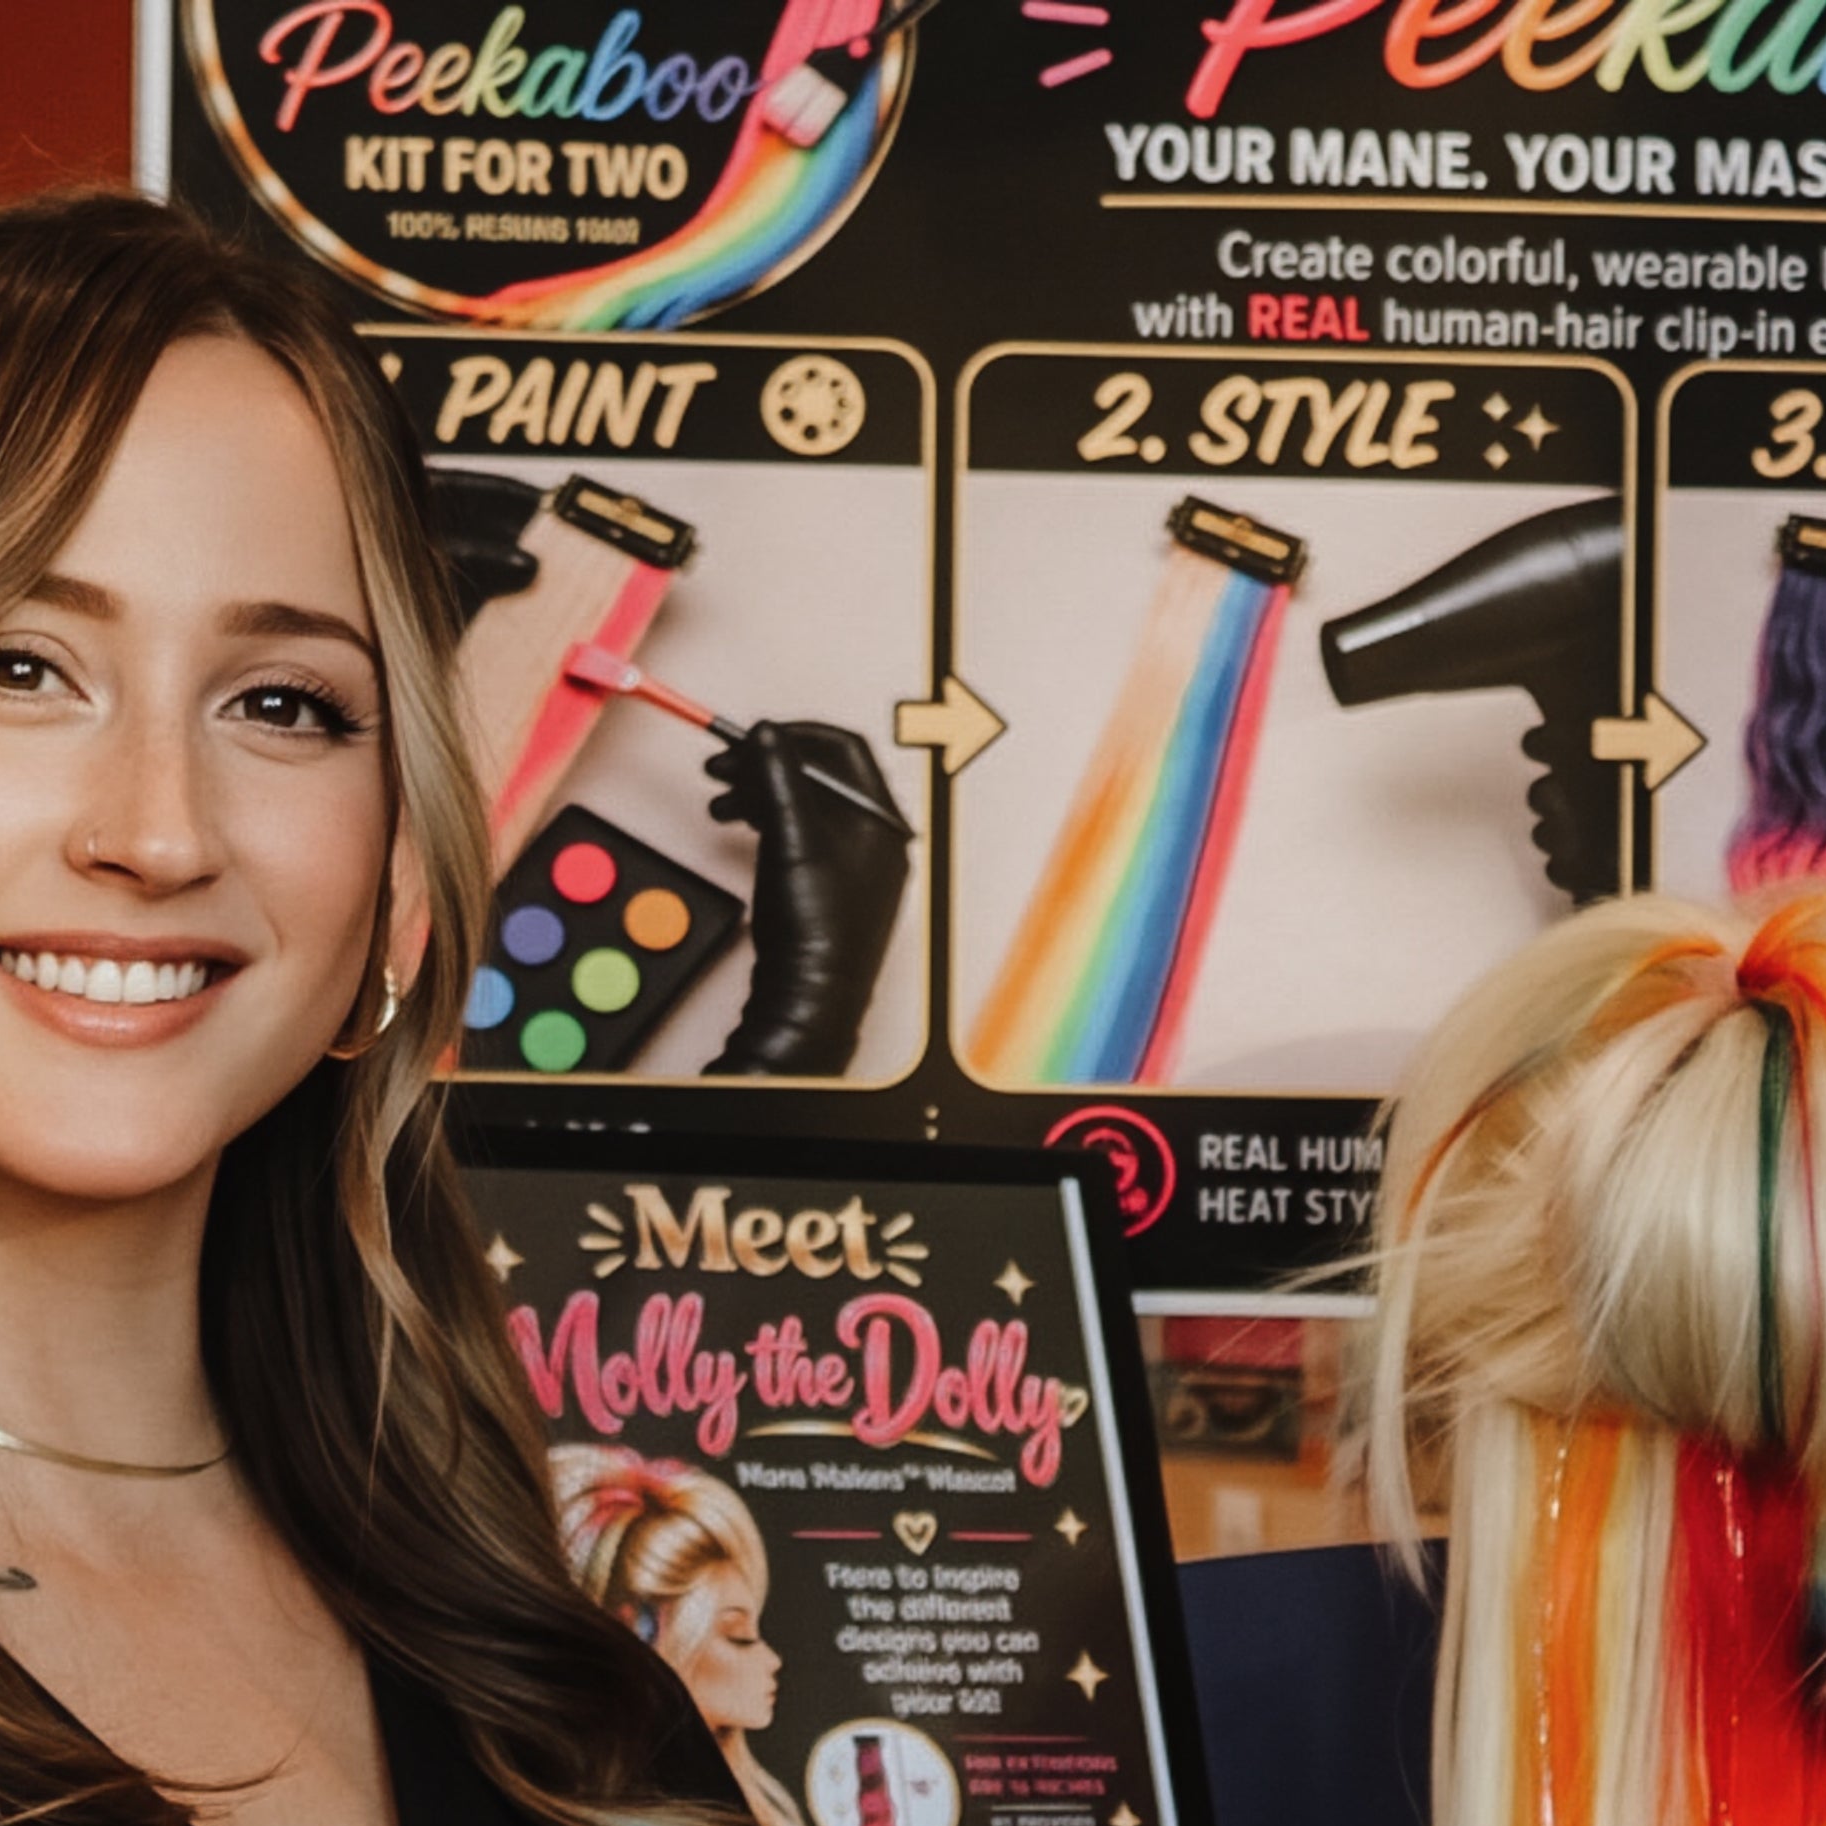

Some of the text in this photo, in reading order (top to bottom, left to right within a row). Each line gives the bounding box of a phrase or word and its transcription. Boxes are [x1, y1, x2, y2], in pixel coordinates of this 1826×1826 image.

[259, 0, 762, 132] Peekaboo
[344, 136, 689, 200] KIT FOR TWO
[1104, 123, 1275, 184] YOUR
[1288, 127, 1488, 190] MANE.
[1504, 134, 1676, 195] YOUR
[1216, 230, 1374, 281] Create
[1385, 235, 1579, 292] colorful,
[1592, 244, 1807, 293] wearable
[1132, 293, 1234, 339] with
[1247, 293, 1370, 342] REAL
[1382, 297, 1644, 350] human-hair
[1654, 305, 1796, 361] clip-in
[434, 355, 718, 449] PAINT
[1077, 373, 1455, 469] 2. STYLE
[1198, 1132, 1384, 1173] REAL HUM
[624, 1182, 885, 1279] Meet
[1198, 1187, 1374, 1226] HEAT STY
[744, 1315, 854, 1409] the
[836, 1291, 1067, 1488] Dolly
